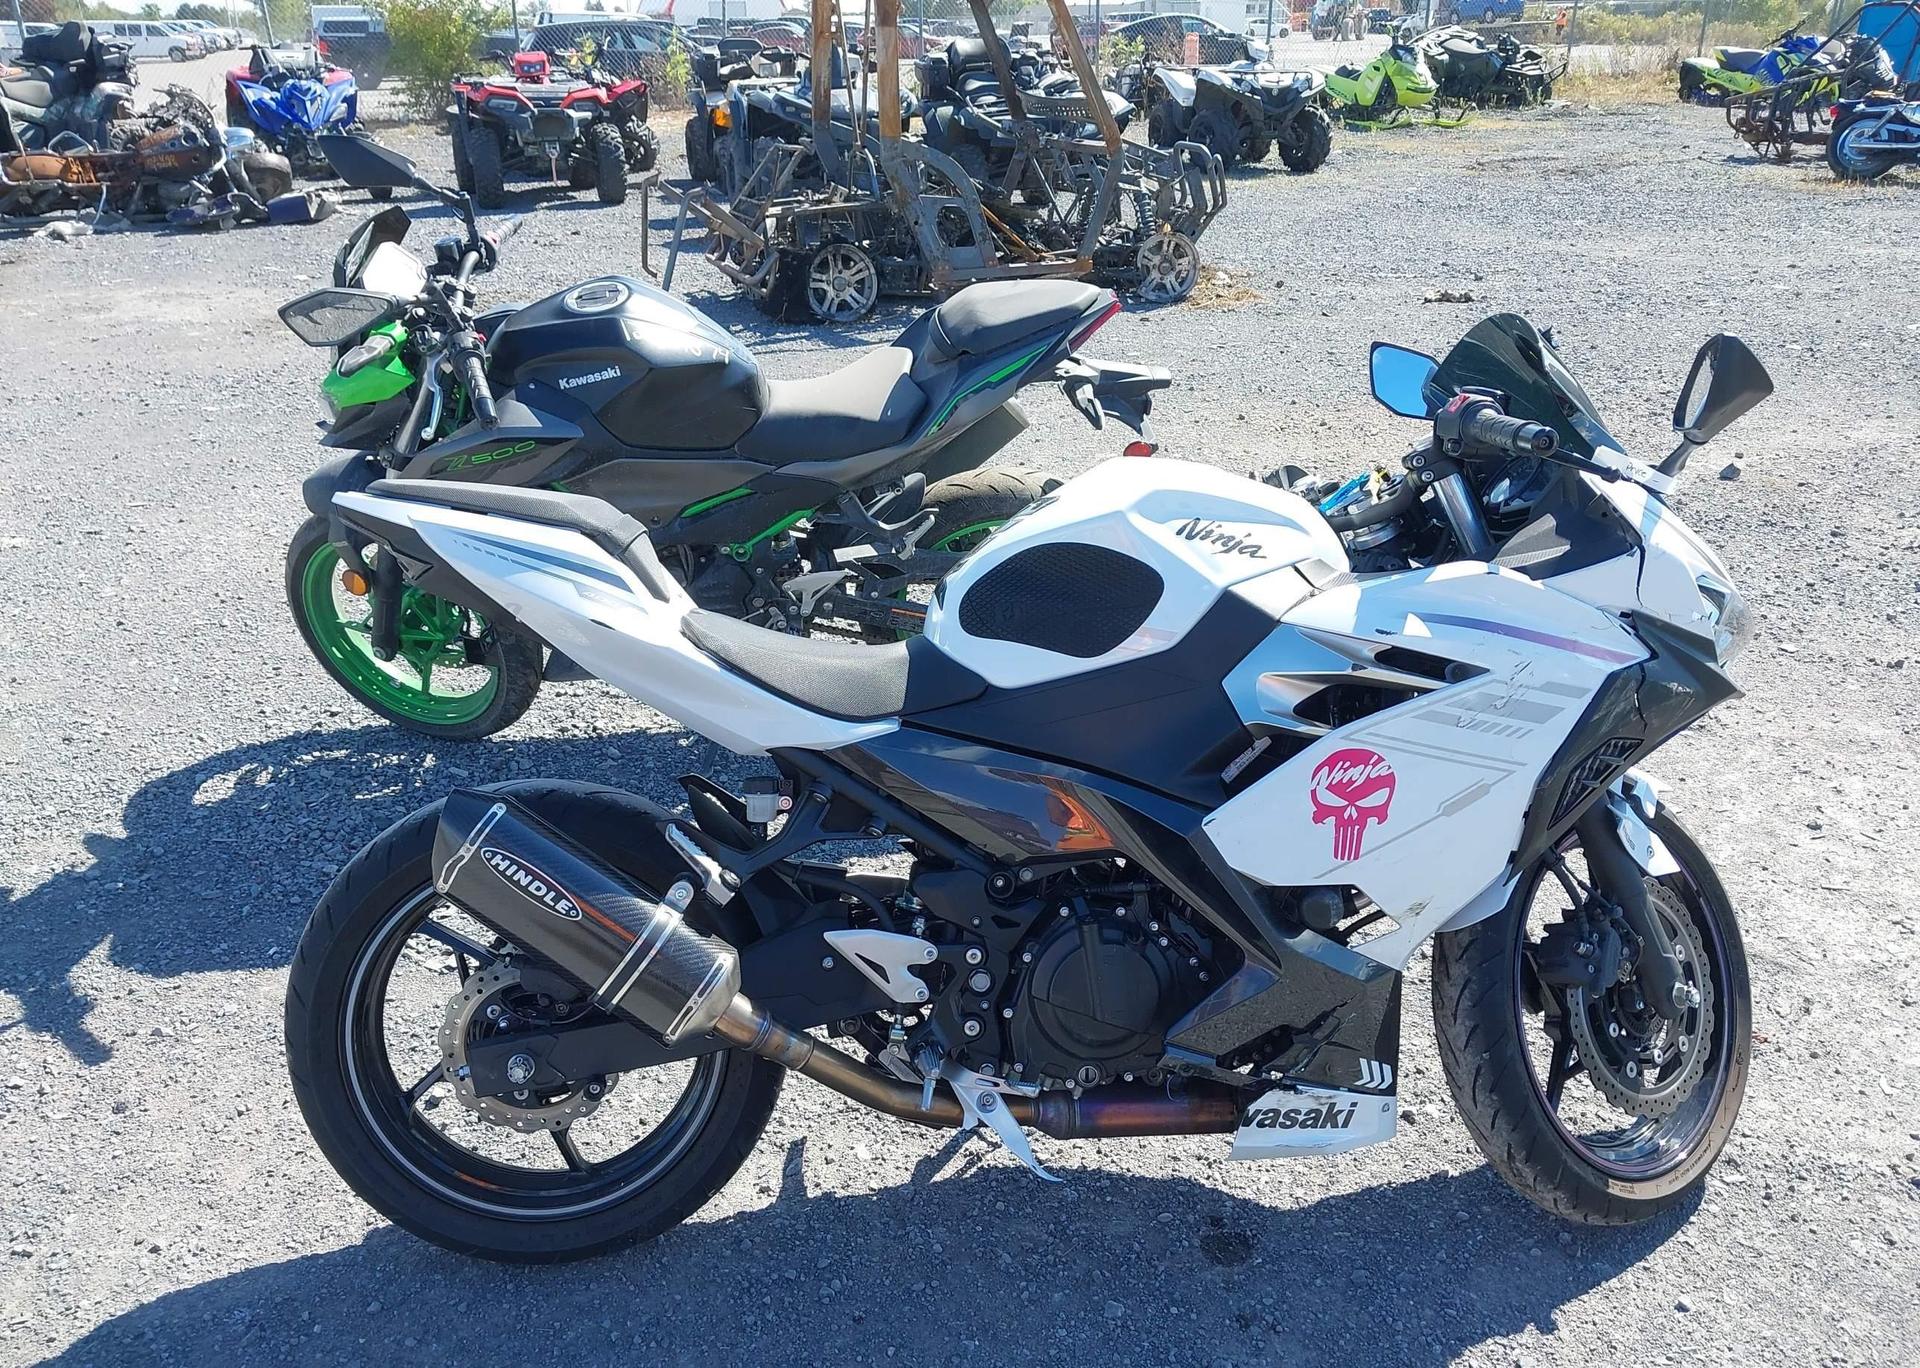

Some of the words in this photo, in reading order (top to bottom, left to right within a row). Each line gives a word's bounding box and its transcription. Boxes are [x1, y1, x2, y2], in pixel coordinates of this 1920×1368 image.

[559, 365, 621, 390] Kawasaki
[1175, 517, 1267, 559] Ninja
[1311, 754, 1394, 793] Ninja
[489, 854, 573, 915] HINDLE
